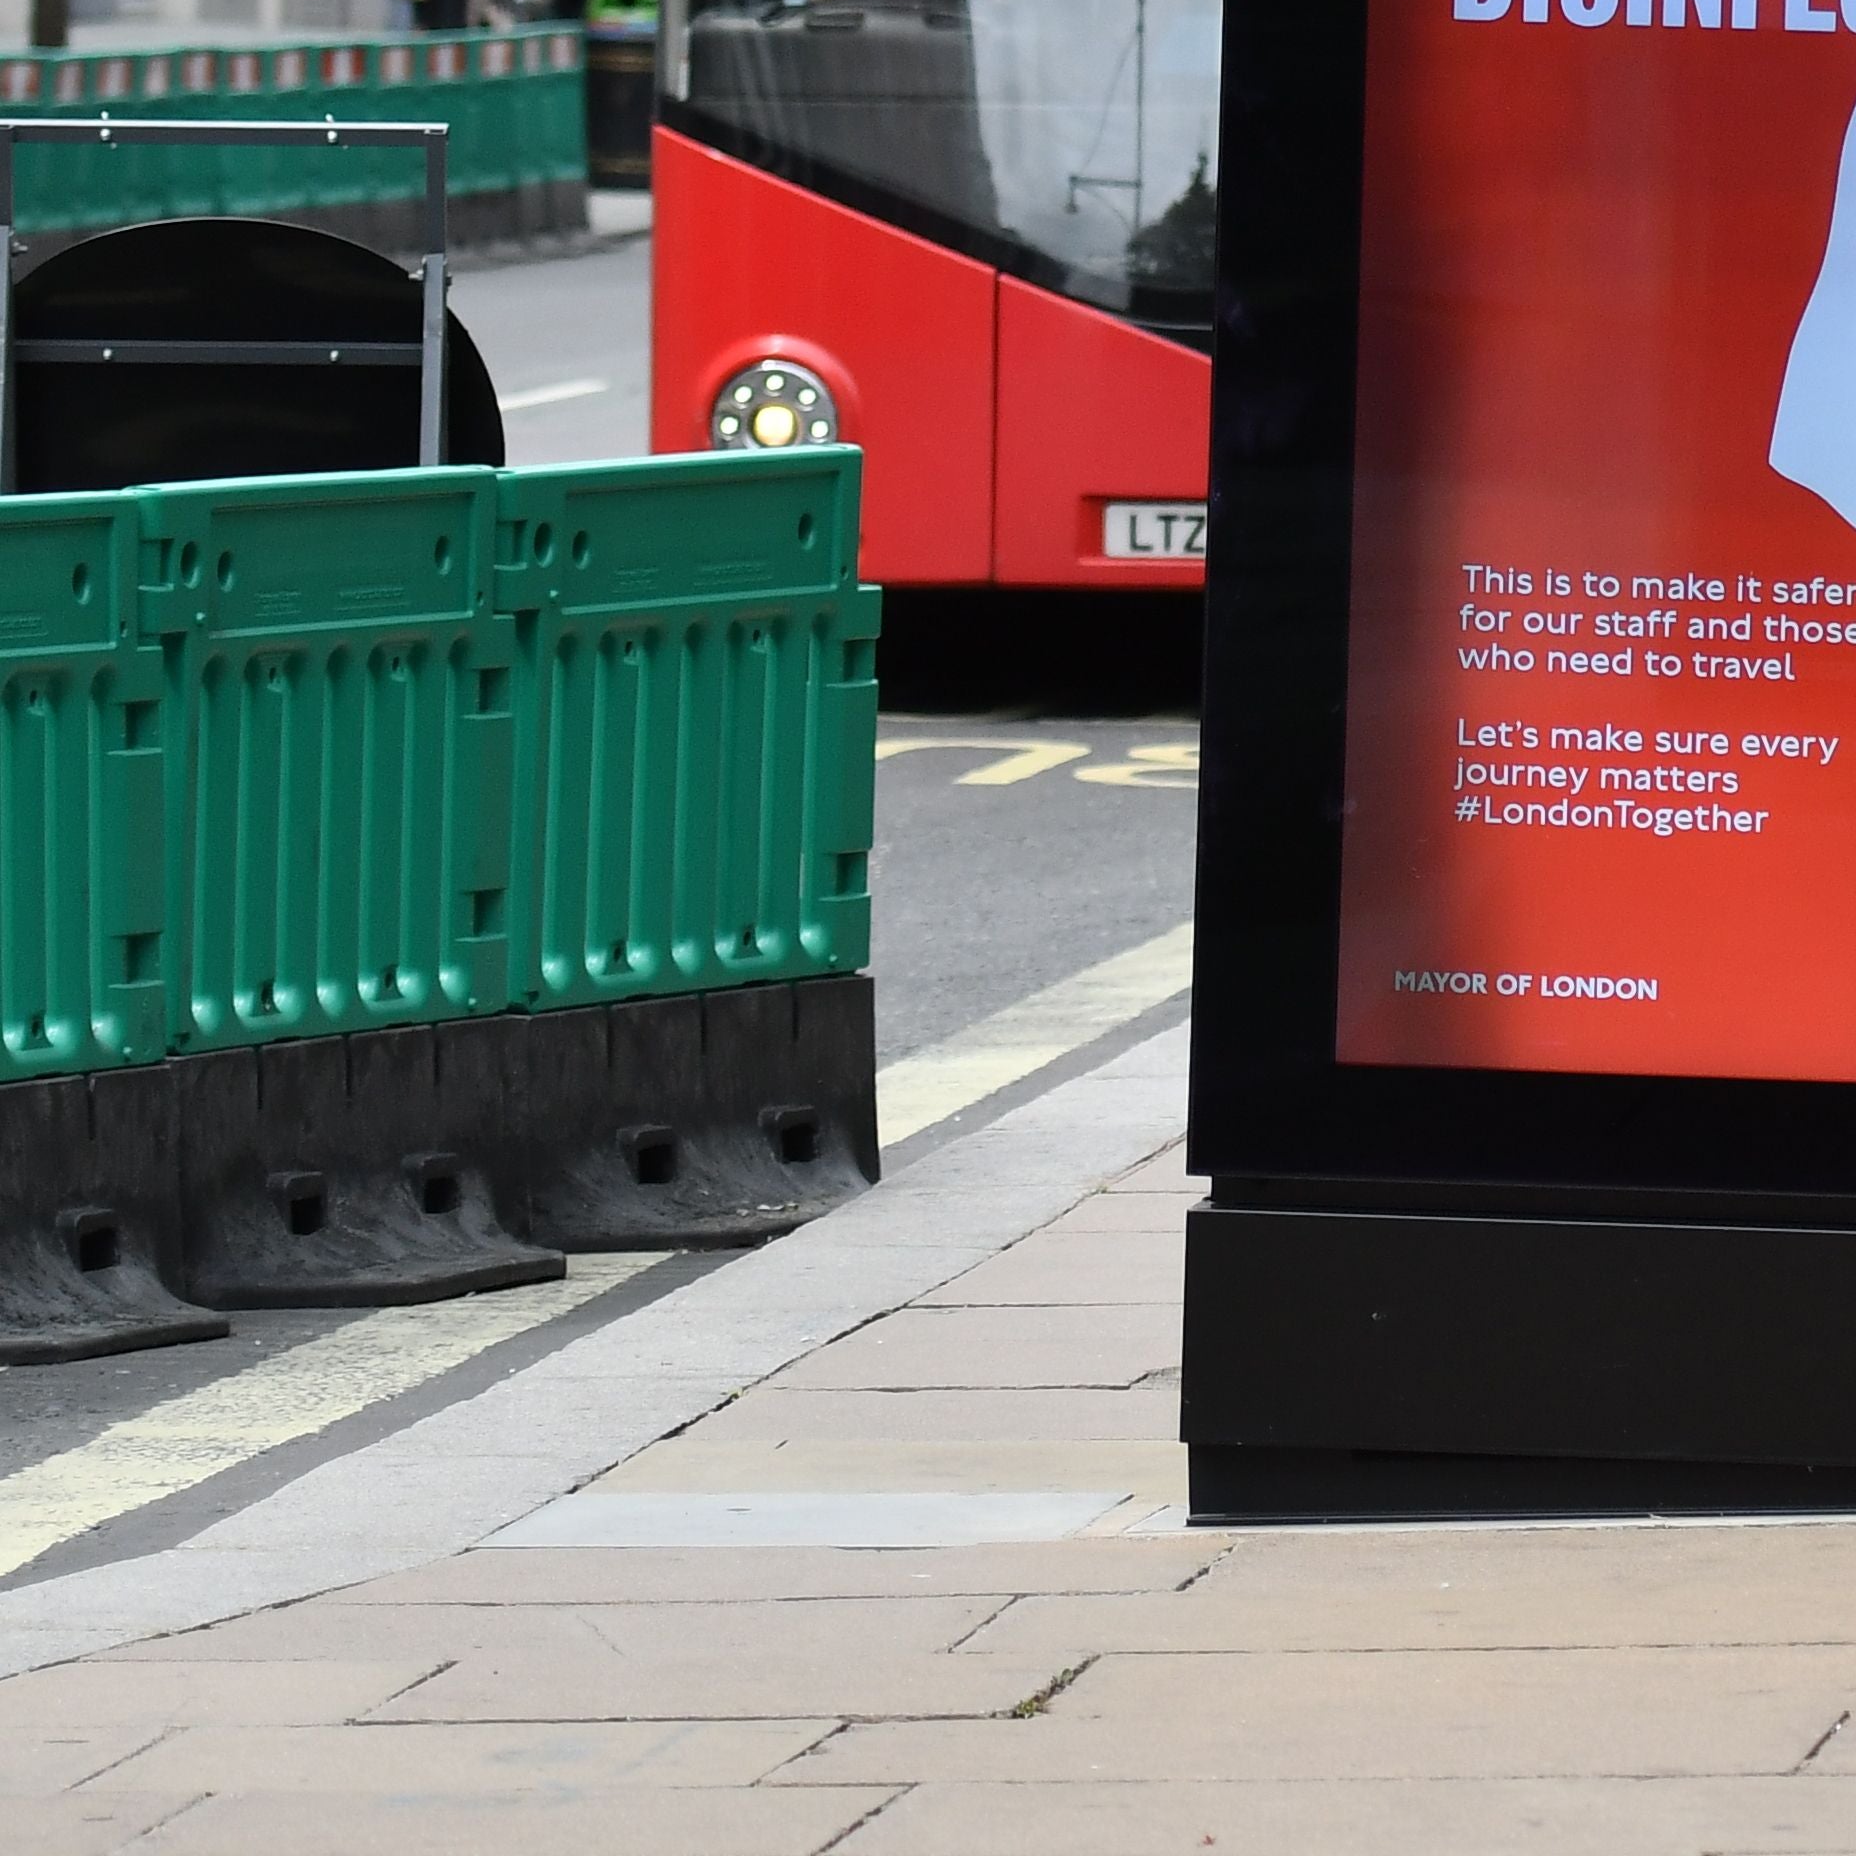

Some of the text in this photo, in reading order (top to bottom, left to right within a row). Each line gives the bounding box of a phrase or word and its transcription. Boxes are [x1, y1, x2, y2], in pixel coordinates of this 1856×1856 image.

[1129, 514, 1205, 553] LTZ
[1462, 565, 1533, 595] This
[1546, 568, 1571, 596] is
[1582, 571, 1620, 598] to
[1632, 572, 1725, 601] make
[1737, 574, 1762, 603] it
[1459, 603, 1512, 633] for
[1523, 612, 1584, 635] our
[1594, 609, 1677, 638] staff
[1687, 612, 1751, 641] and
[1458, 642, 1796, 681] who need to travel
[1551, 723, 1643, 752] make
[1655, 731, 1729, 755] sure
[1741, 734, 1839, 765] every
[1454, 757, 1739, 796] journey matters
[1454, 795, 1769, 837] #LondonTogether
[1394, 970, 1658, 1001] MAYOR OF LONDON
